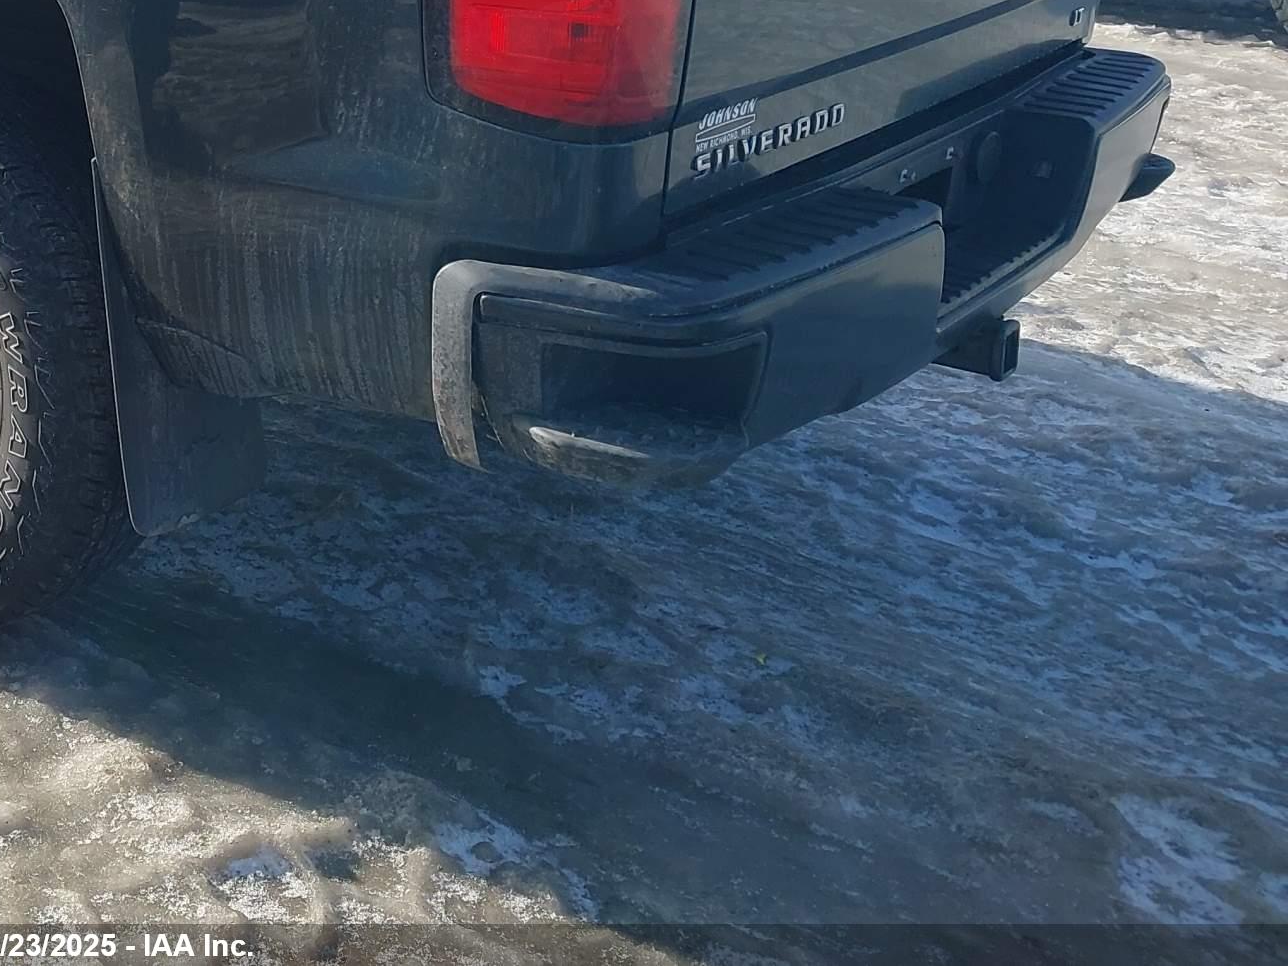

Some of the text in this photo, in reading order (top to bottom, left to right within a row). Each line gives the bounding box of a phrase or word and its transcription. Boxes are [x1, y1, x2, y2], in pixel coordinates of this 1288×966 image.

[698, 98, 759, 131] JOHNSON
[694, 102, 846, 174] SILVERADO
[695, 140, 710, 153] NEW
